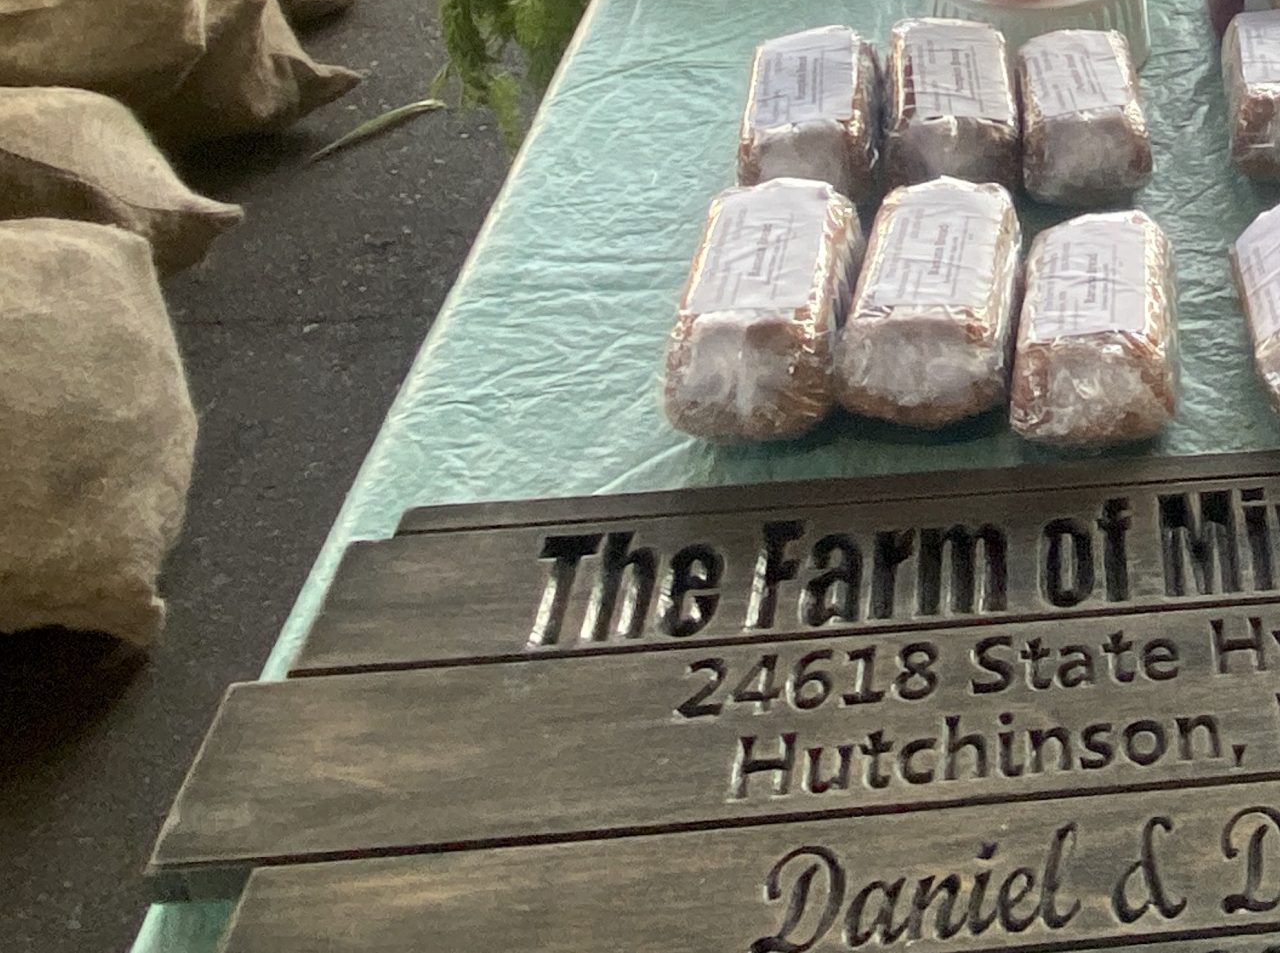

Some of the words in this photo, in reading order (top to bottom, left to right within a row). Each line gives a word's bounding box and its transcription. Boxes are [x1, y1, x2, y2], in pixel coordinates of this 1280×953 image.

[529, 530, 725, 648] The
[743, 520, 1008, 632] Farm
[1036, 496, 1132, 608] of
[674, 640, 940, 721] 24618
[969, 630, 1181, 696] State
[727, 712, 1247, 802] Hutchinson,
[750, 822, 1081, 953] Daniel
